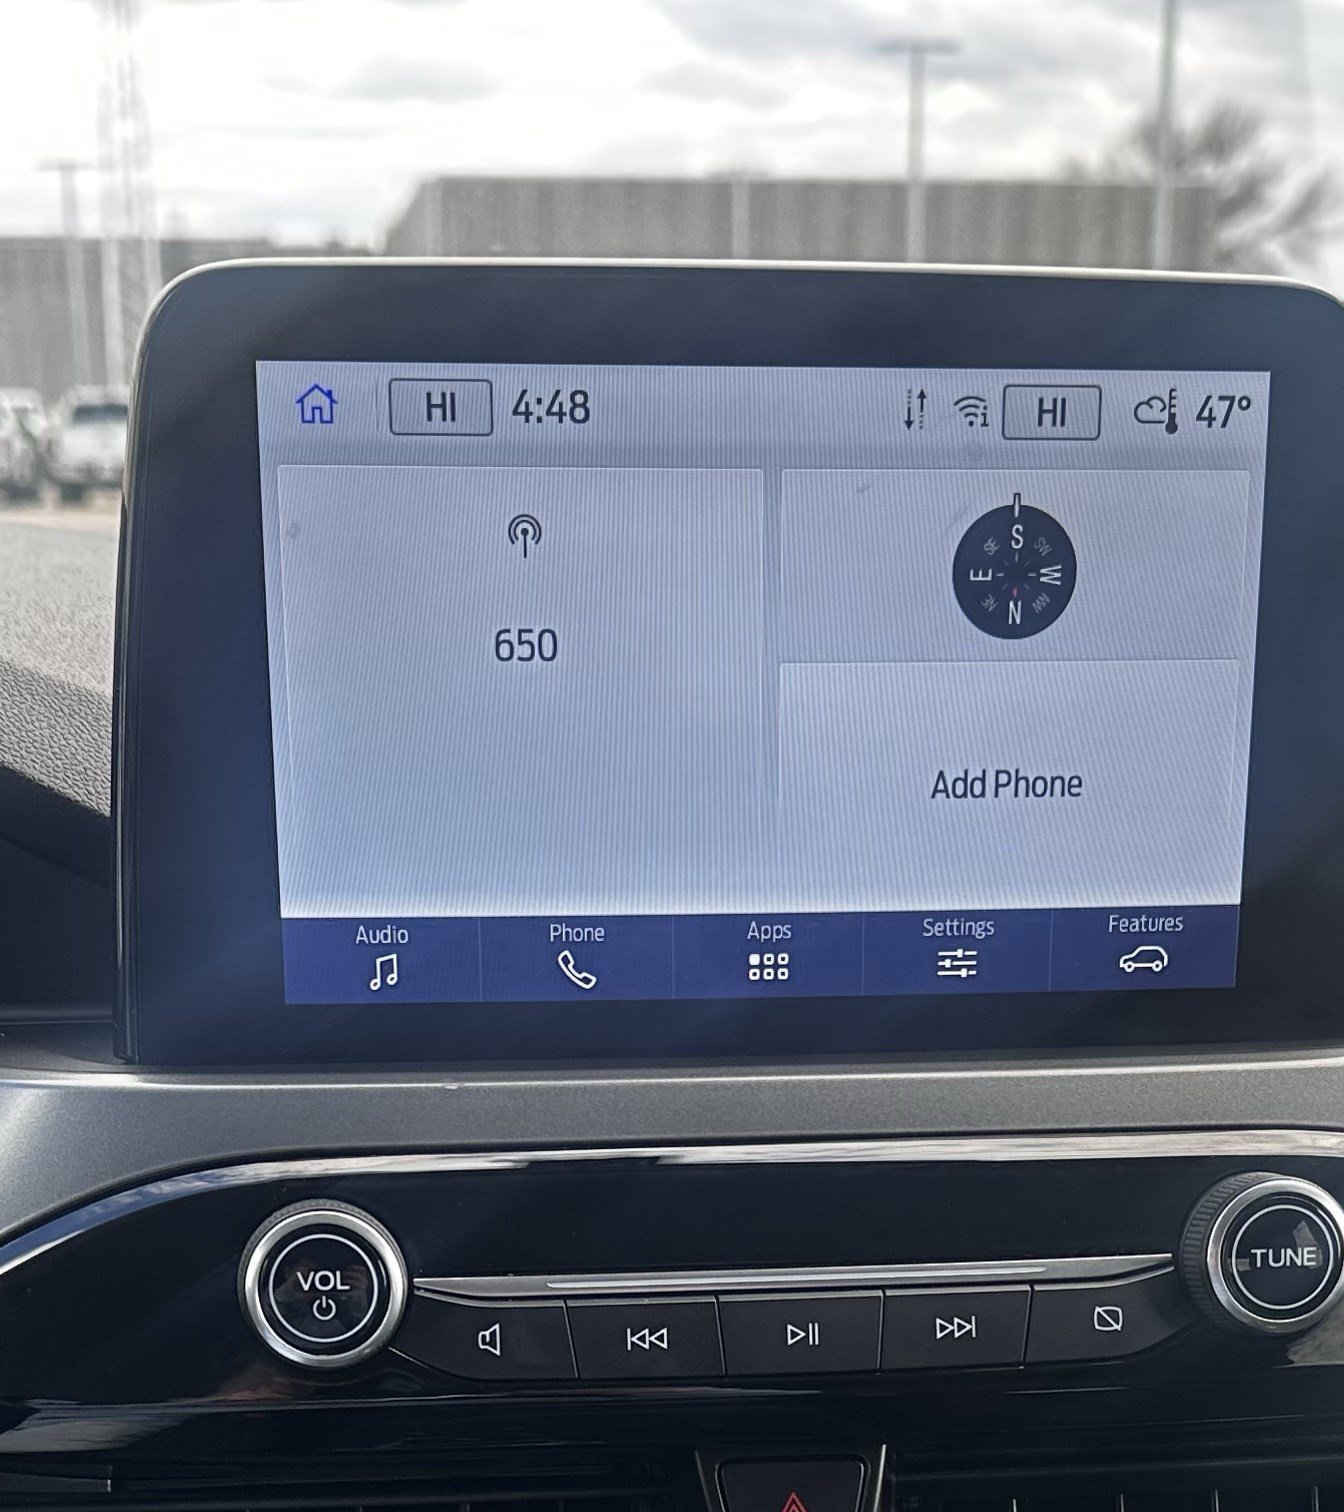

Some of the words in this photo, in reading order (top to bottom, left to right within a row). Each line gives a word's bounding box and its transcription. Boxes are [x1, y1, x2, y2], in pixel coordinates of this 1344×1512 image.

[426, 391, 456, 422] HI
[512, 389, 591, 424] 4:48
[1037, 397, 1067, 427] HI
[1196, 395, 1252, 428] 47°
[1011, 524, 1024, 549] S
[969, 567, 993, 582] E
[1039, 564, 1063, 586] W
[1008, 600, 1022, 625] N
[495, 628, 558, 662] 650
[931, 768, 987, 799] Add
[994, 768, 1084, 799] Phone
[550, 923, 605, 943] Phone
[747, 920, 792, 941] Apps
[922, 917, 996, 938] Settings
[1108, 913, 1185, 933] Features
[356, 925, 410, 945] Audio
[1250, 1246, 1317, 1268] TUNE
[296, 1269, 351, 1292] VOL
